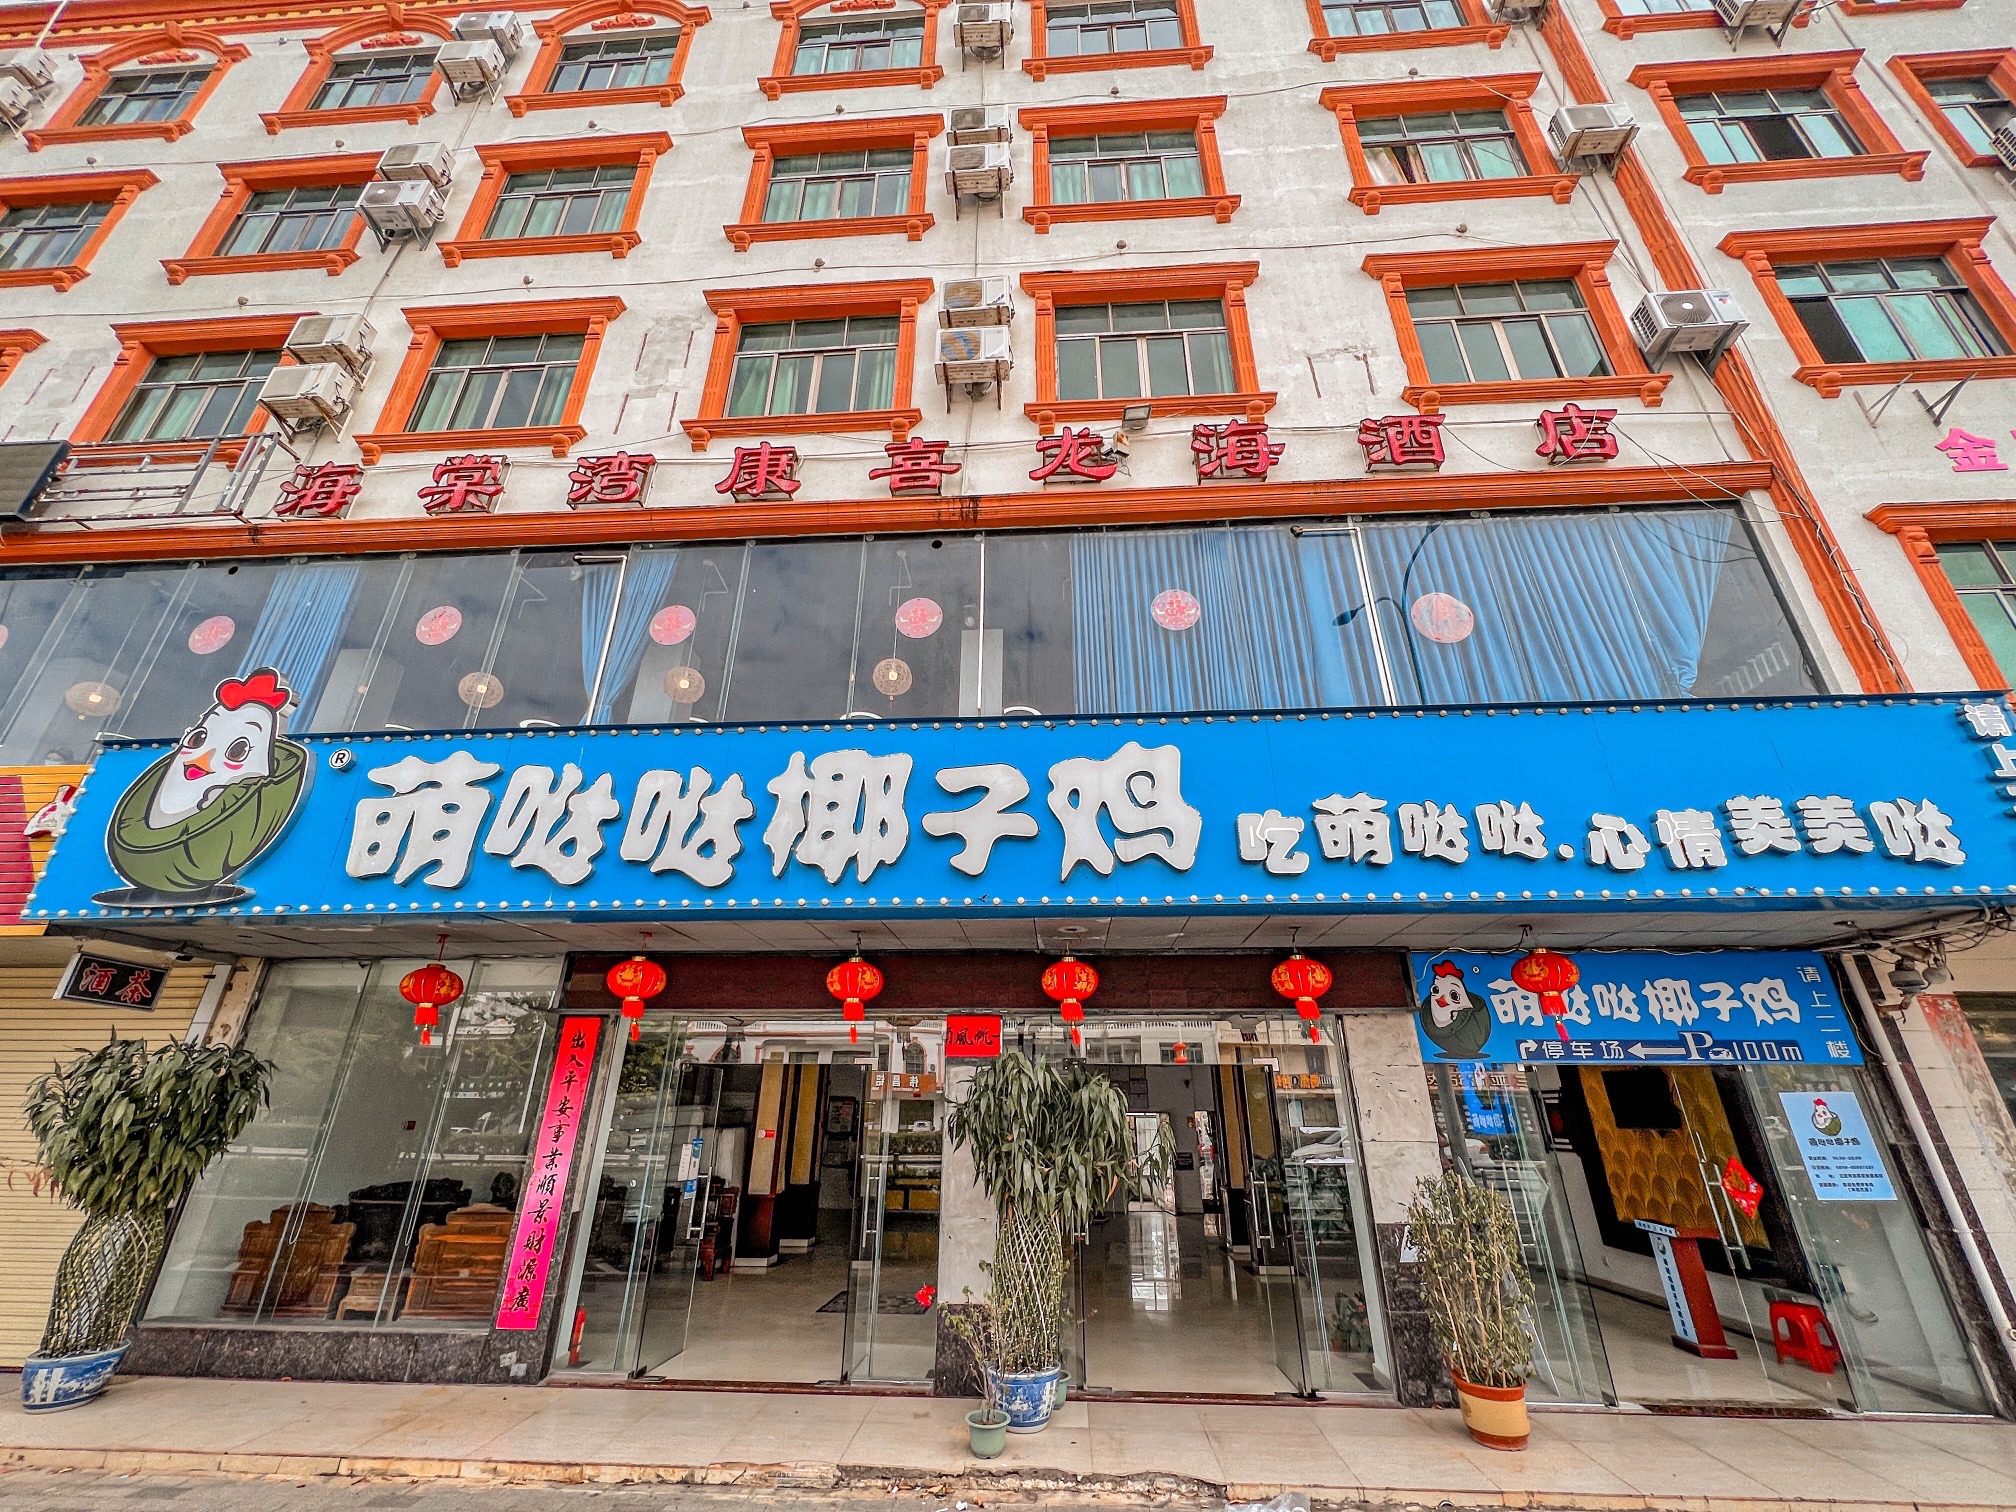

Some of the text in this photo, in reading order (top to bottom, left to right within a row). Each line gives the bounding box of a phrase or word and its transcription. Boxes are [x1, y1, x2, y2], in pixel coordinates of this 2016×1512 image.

[273, 402, 1619, 517] 海棠湾康喜龙海酒店
[1935, 427, 2016, 472] 金
[346, 741, 1202, 888] 萌哒哒椰子鸡
[1542, 1040, 1625, 1060] 停车场
[1796, 966, 1852, 1059] 请上二楼
